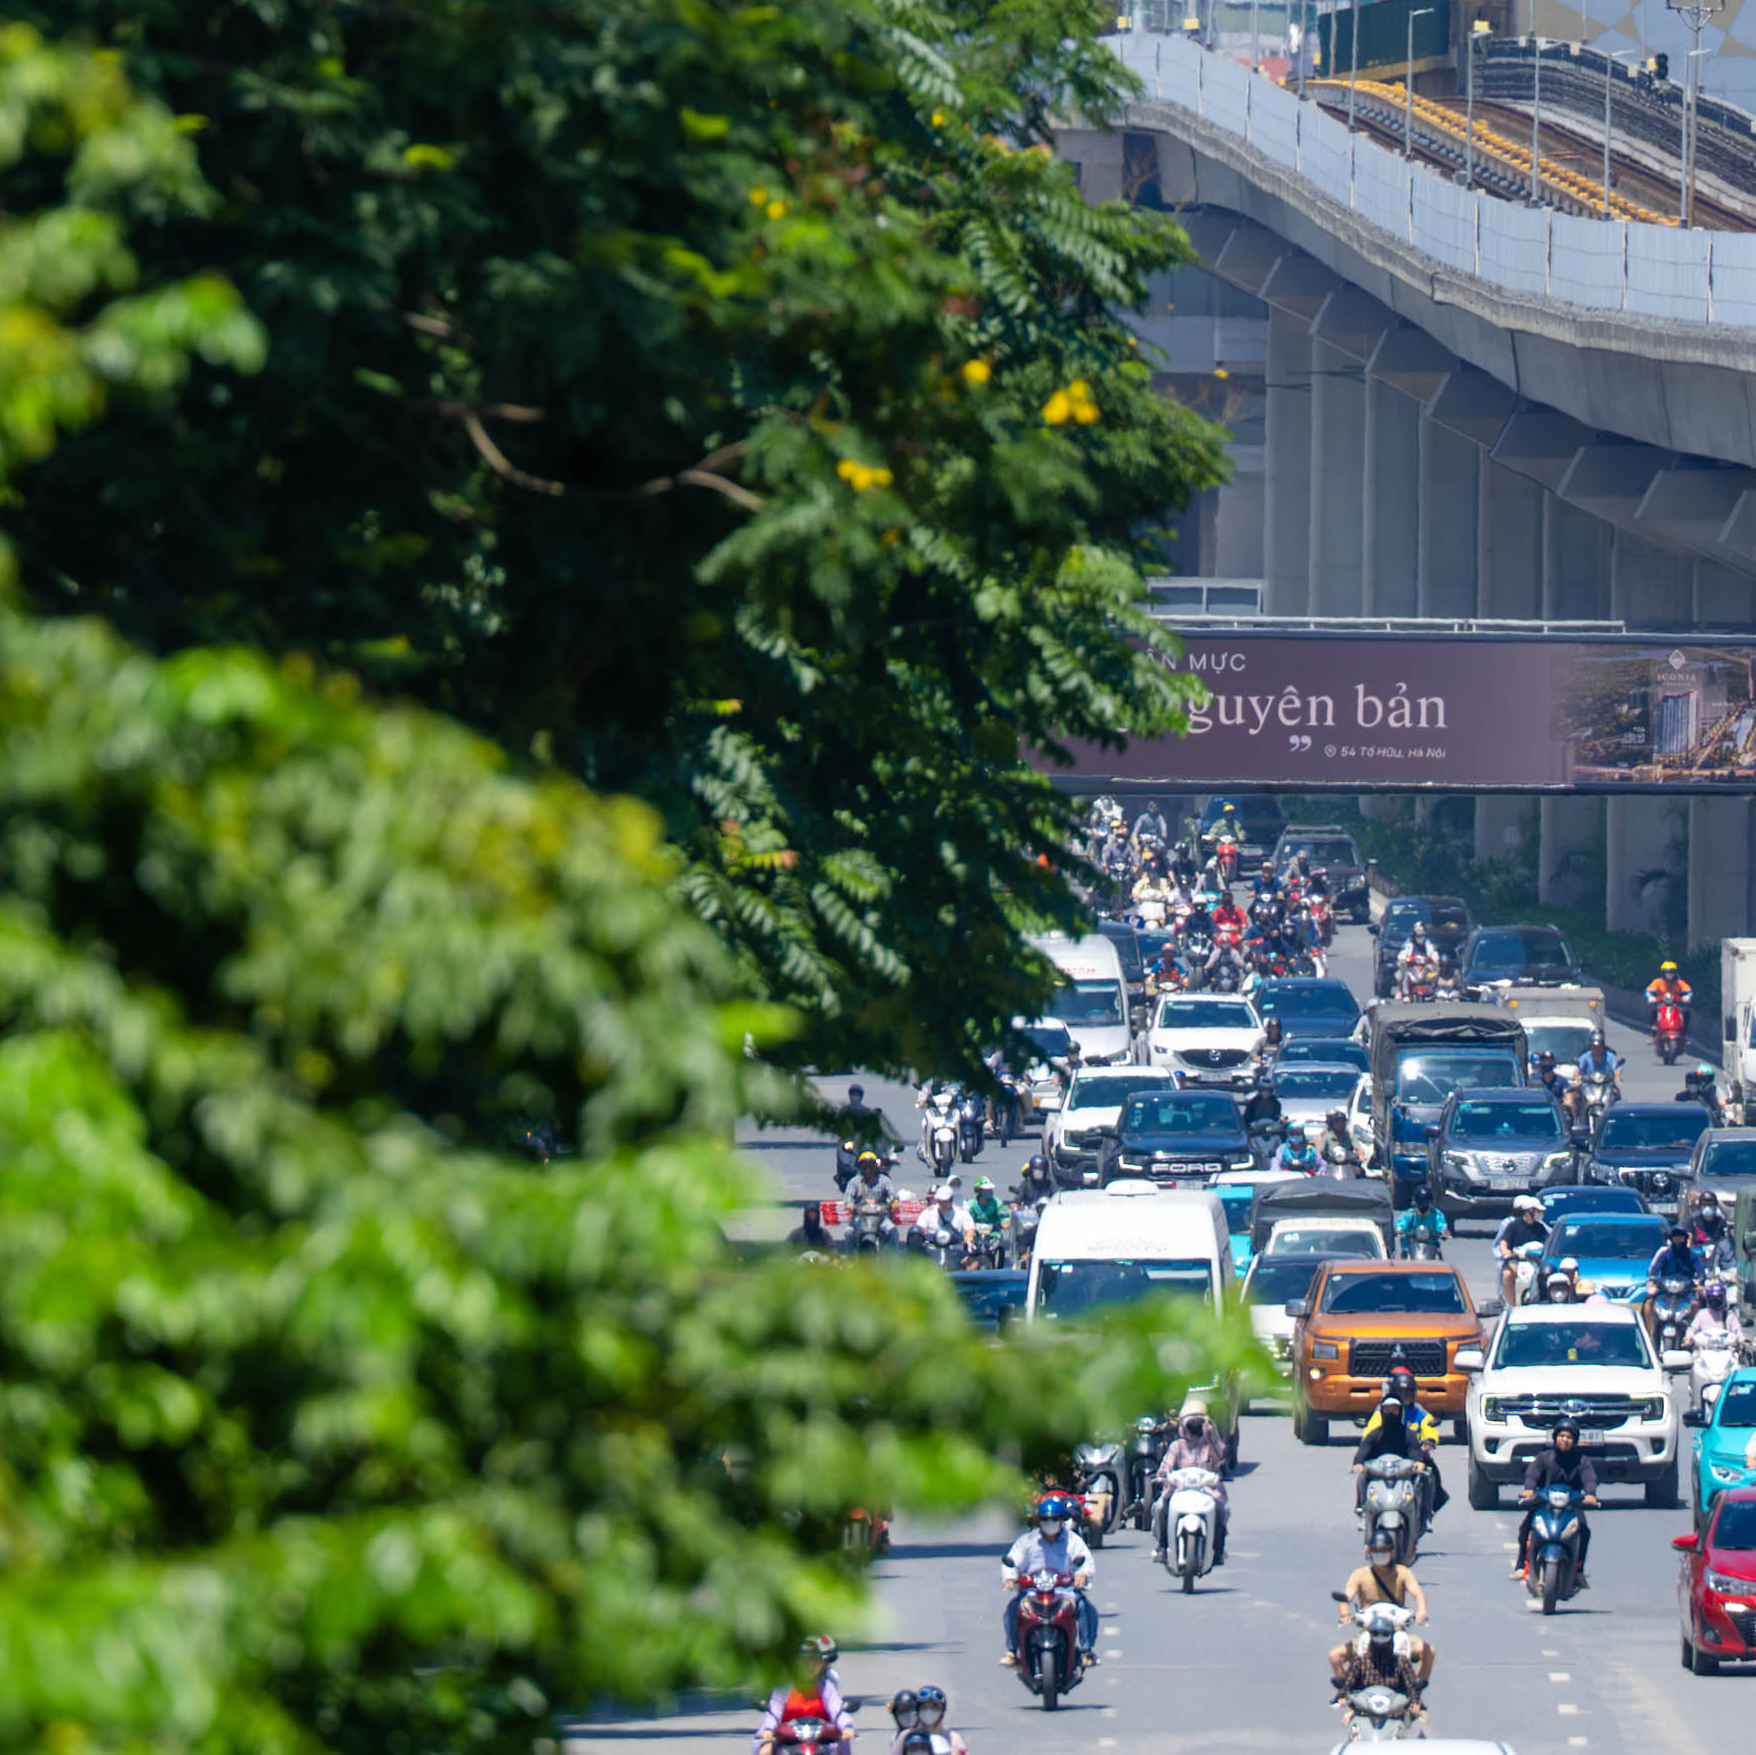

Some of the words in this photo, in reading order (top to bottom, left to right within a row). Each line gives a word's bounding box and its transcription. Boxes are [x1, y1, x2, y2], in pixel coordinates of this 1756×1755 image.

[1189, 651, 1246, 674] MỰC
[1186, 685, 1336, 735] guyên
[1354, 682, 1449, 729] bản
[1340, 746, 1356, 757] 54
[1151, 1163, 1222, 1174] FORD
